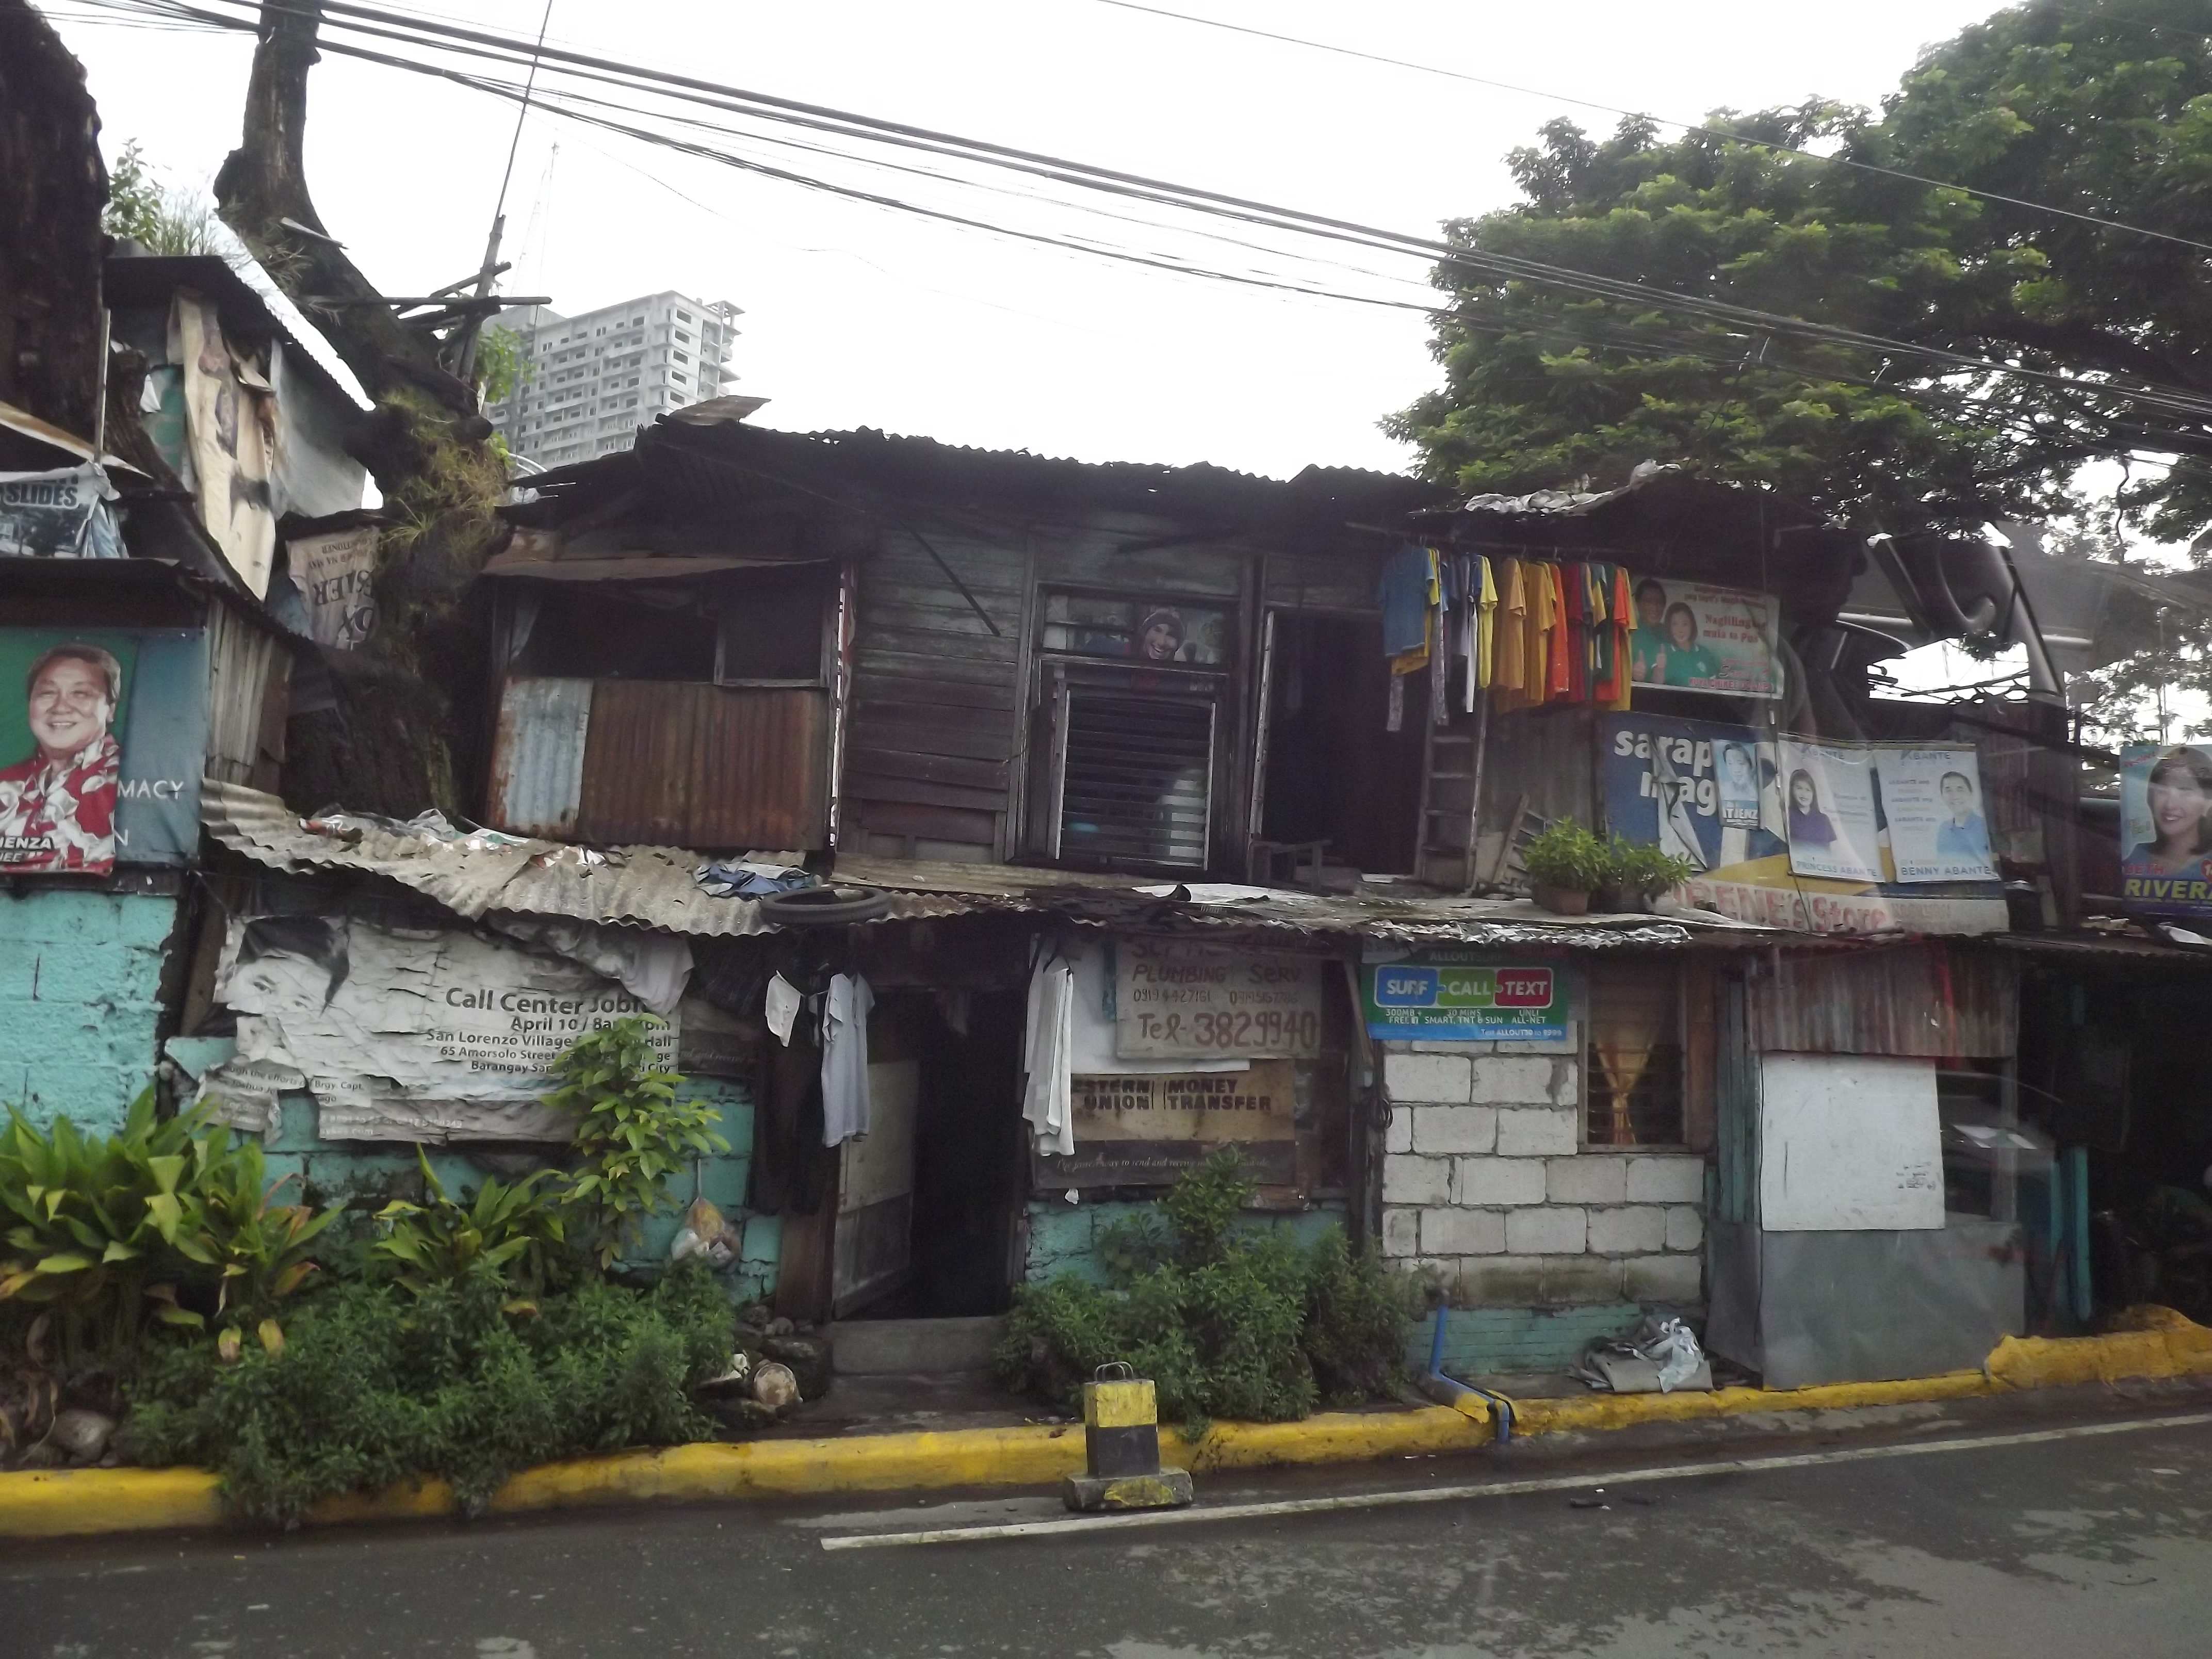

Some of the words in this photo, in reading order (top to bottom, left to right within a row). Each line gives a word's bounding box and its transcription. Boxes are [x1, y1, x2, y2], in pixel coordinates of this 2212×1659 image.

[4, 483, 78, 507] SLIDES
[1613, 730, 1714, 777] sarap
[1901, 867, 1939, 875] BENNY
[1944, 866, 1991, 875] ABANTE
[2124, 879, 2212, 900] RIVER
[1386, 979, 1428, 996] SURF
[1447, 981, 1491, 996] CALL
[1505, 981, 1548, 996] TEXT
[446, 987, 494, 1011] Call
[500, 992, 583, 1015] Center
[510, 1015, 552, 1033] April
[559, 1018, 578, 1031] 10
[1193, 1011, 1319, 1049] 3829940
[426, 1028, 454, 1042] San
[459, 1031, 518, 1045] Lorenzo
[522, 1035, 572, 1050] Village
[441, 1046, 456, 1056] 65
[459, 1048, 516, 1058] Amorsolo
[521, 1051, 556, 1060] Street
[471, 1060, 528, 1074] Barangay
[1167, 1079, 1238, 1094] MONEY
[1083, 1095, 1150, 1111] UNION
[1167, 1095, 1272, 1111] TRANSFER
